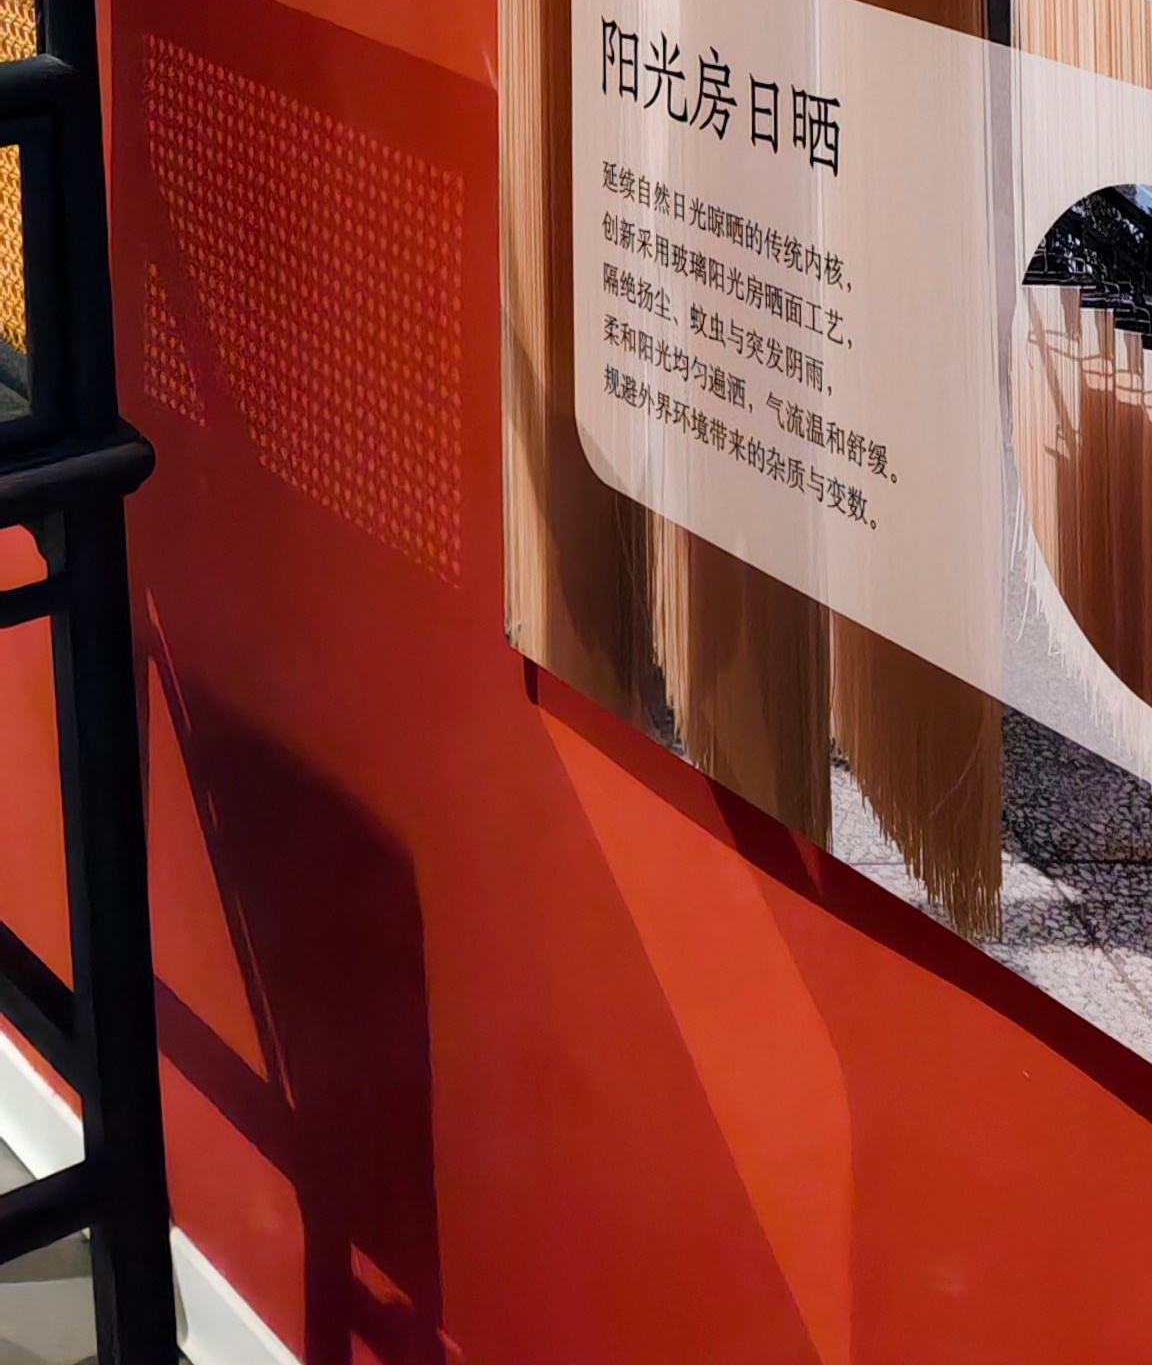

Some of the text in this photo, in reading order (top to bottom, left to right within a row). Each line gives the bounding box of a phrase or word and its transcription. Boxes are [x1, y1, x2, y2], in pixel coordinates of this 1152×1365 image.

[600, 15, 840, 178] 阳光房日晒
[602, 161, 853, 292] 延续自然日光晾晒的传统内核，
[602, 210, 853, 350] 创新采用玻璃阳光房晒面工艺，
[603, 262, 833, 397] 隔绝扬尘、蚊虫与突发阴雨，
[603, 313, 899, 485] 柔和阳光均匀遍洒，气流温和舒缓。
[603, 364, 878, 531] 规避外界环境带来的杂质与变数。
